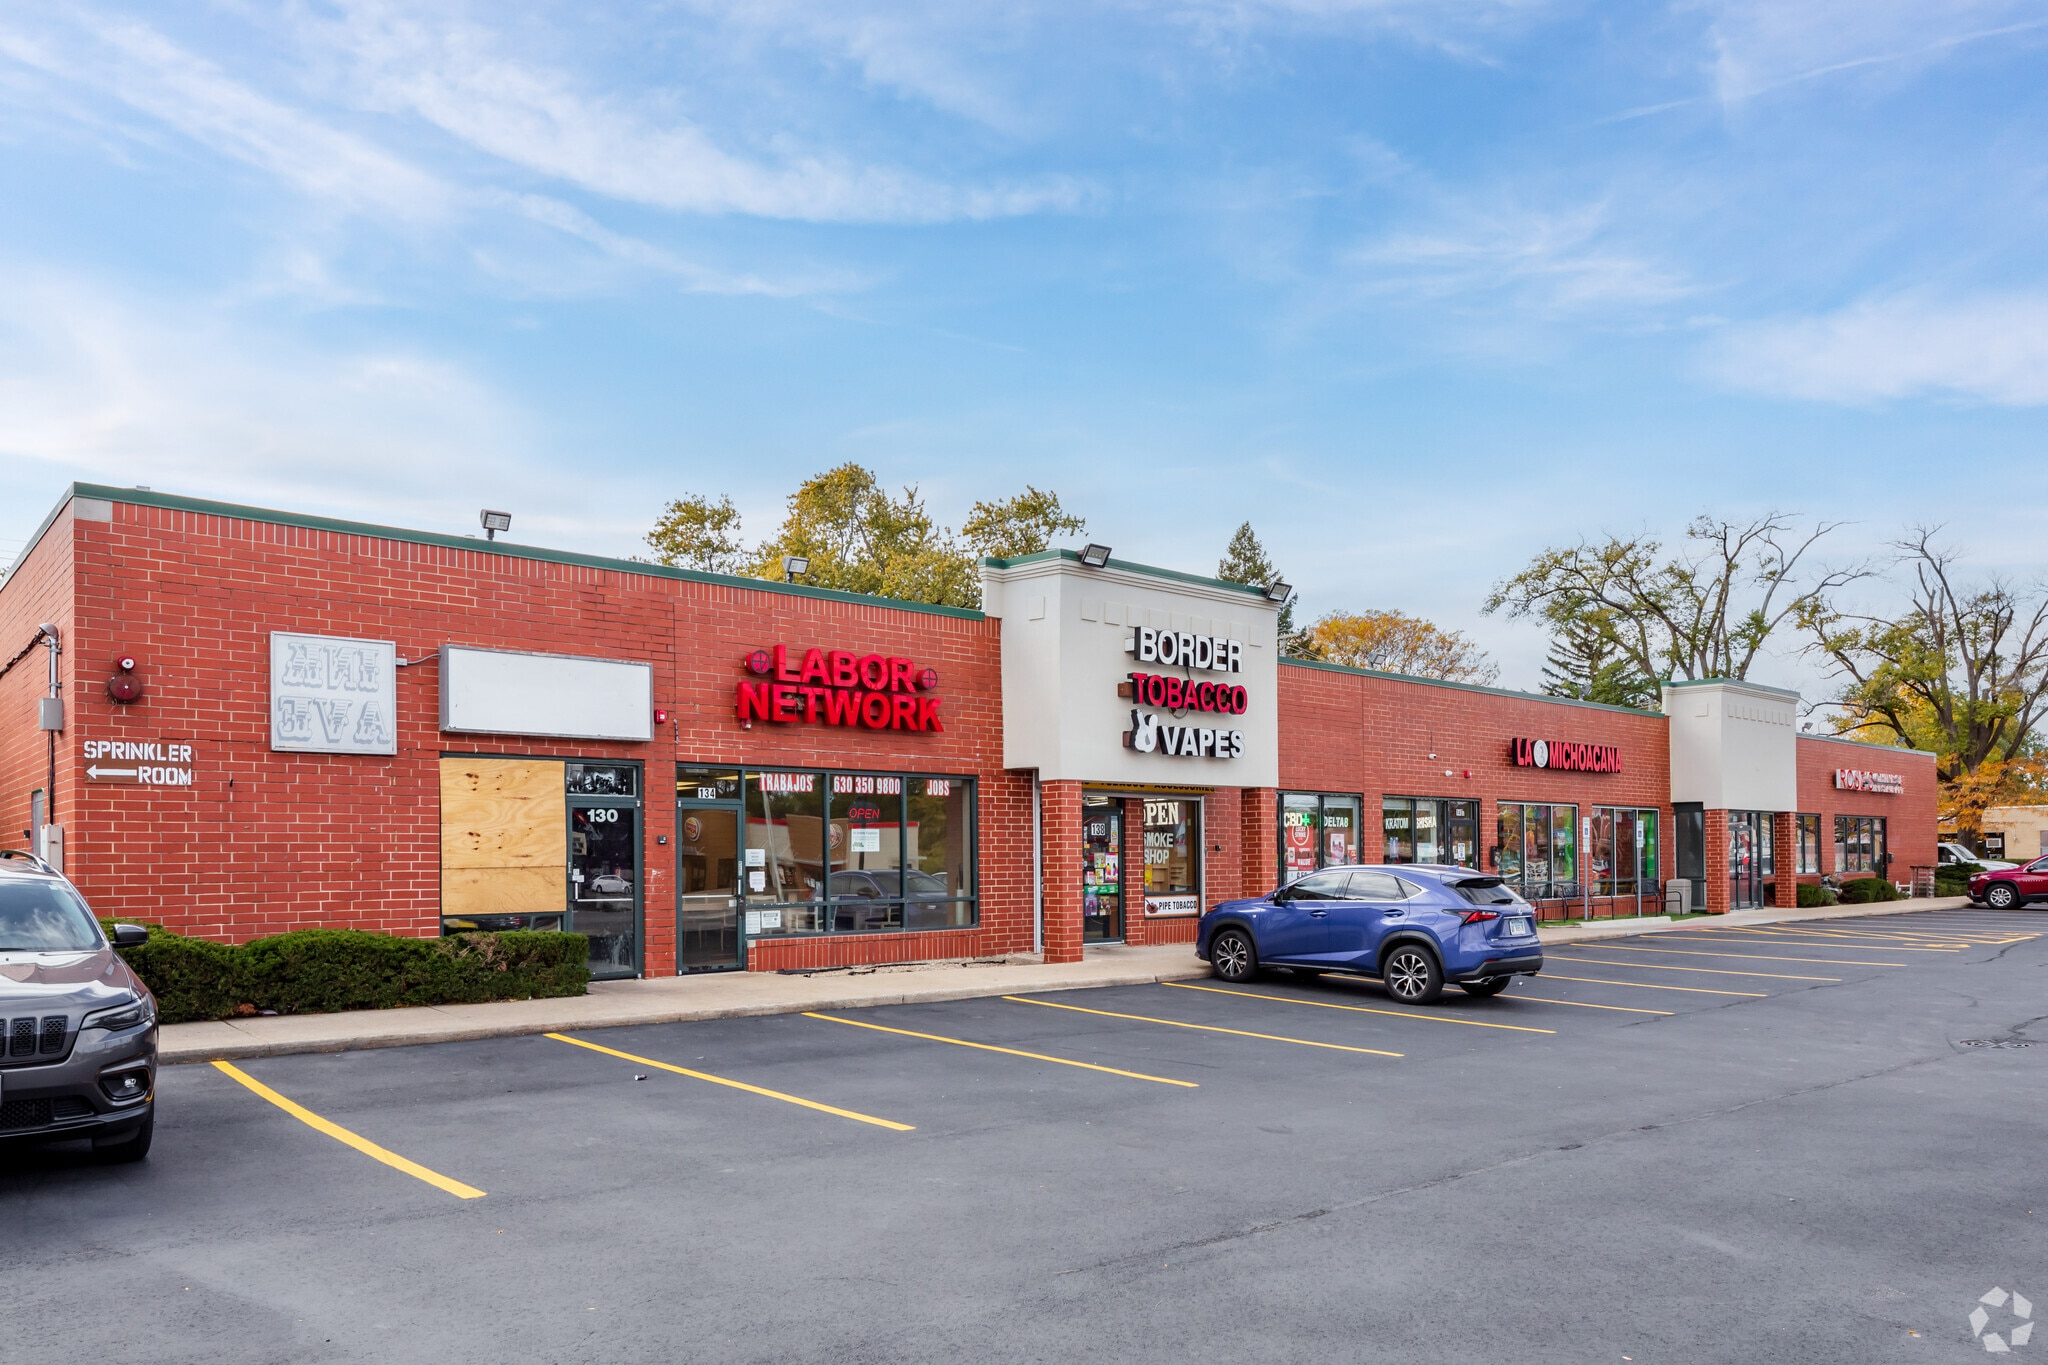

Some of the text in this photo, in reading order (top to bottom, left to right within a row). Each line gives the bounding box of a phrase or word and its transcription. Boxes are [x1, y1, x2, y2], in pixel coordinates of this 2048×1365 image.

[1137, 626, 1243, 673] BORDER
[773, 644, 916, 693] LABOR
[1130, 672, 1248, 715] TOBACCO
[737, 681, 944, 732] NETWORK
[84, 740, 192, 763] SPRINKLER
[1160, 725, 1246, 759] VAPES
[1515, 738, 1622, 773] LA MICHOACANA
[138, 766, 192, 786] ROOM
[760, 773, 814, 792] TRABAJOS
[834, 776, 900, 795] 630 350 9800
[699, 788, 715, 798] 134
[927, 780, 950, 796] JOBS
[587, 809, 618, 823] 130
[849, 807, 880, 819] OPEN
[1143, 802, 1179, 826] PEN
[1416, 816, 1437, 829] SHISHA
[1091, 823, 1106, 835] 138
[1385, 818, 1408, 830] KRATOM
[1143, 832, 1174, 847] SMOKE
[1144, 850, 1170, 864] SHOP
[1158, 900, 1197, 911] PIPE TOBACCO
